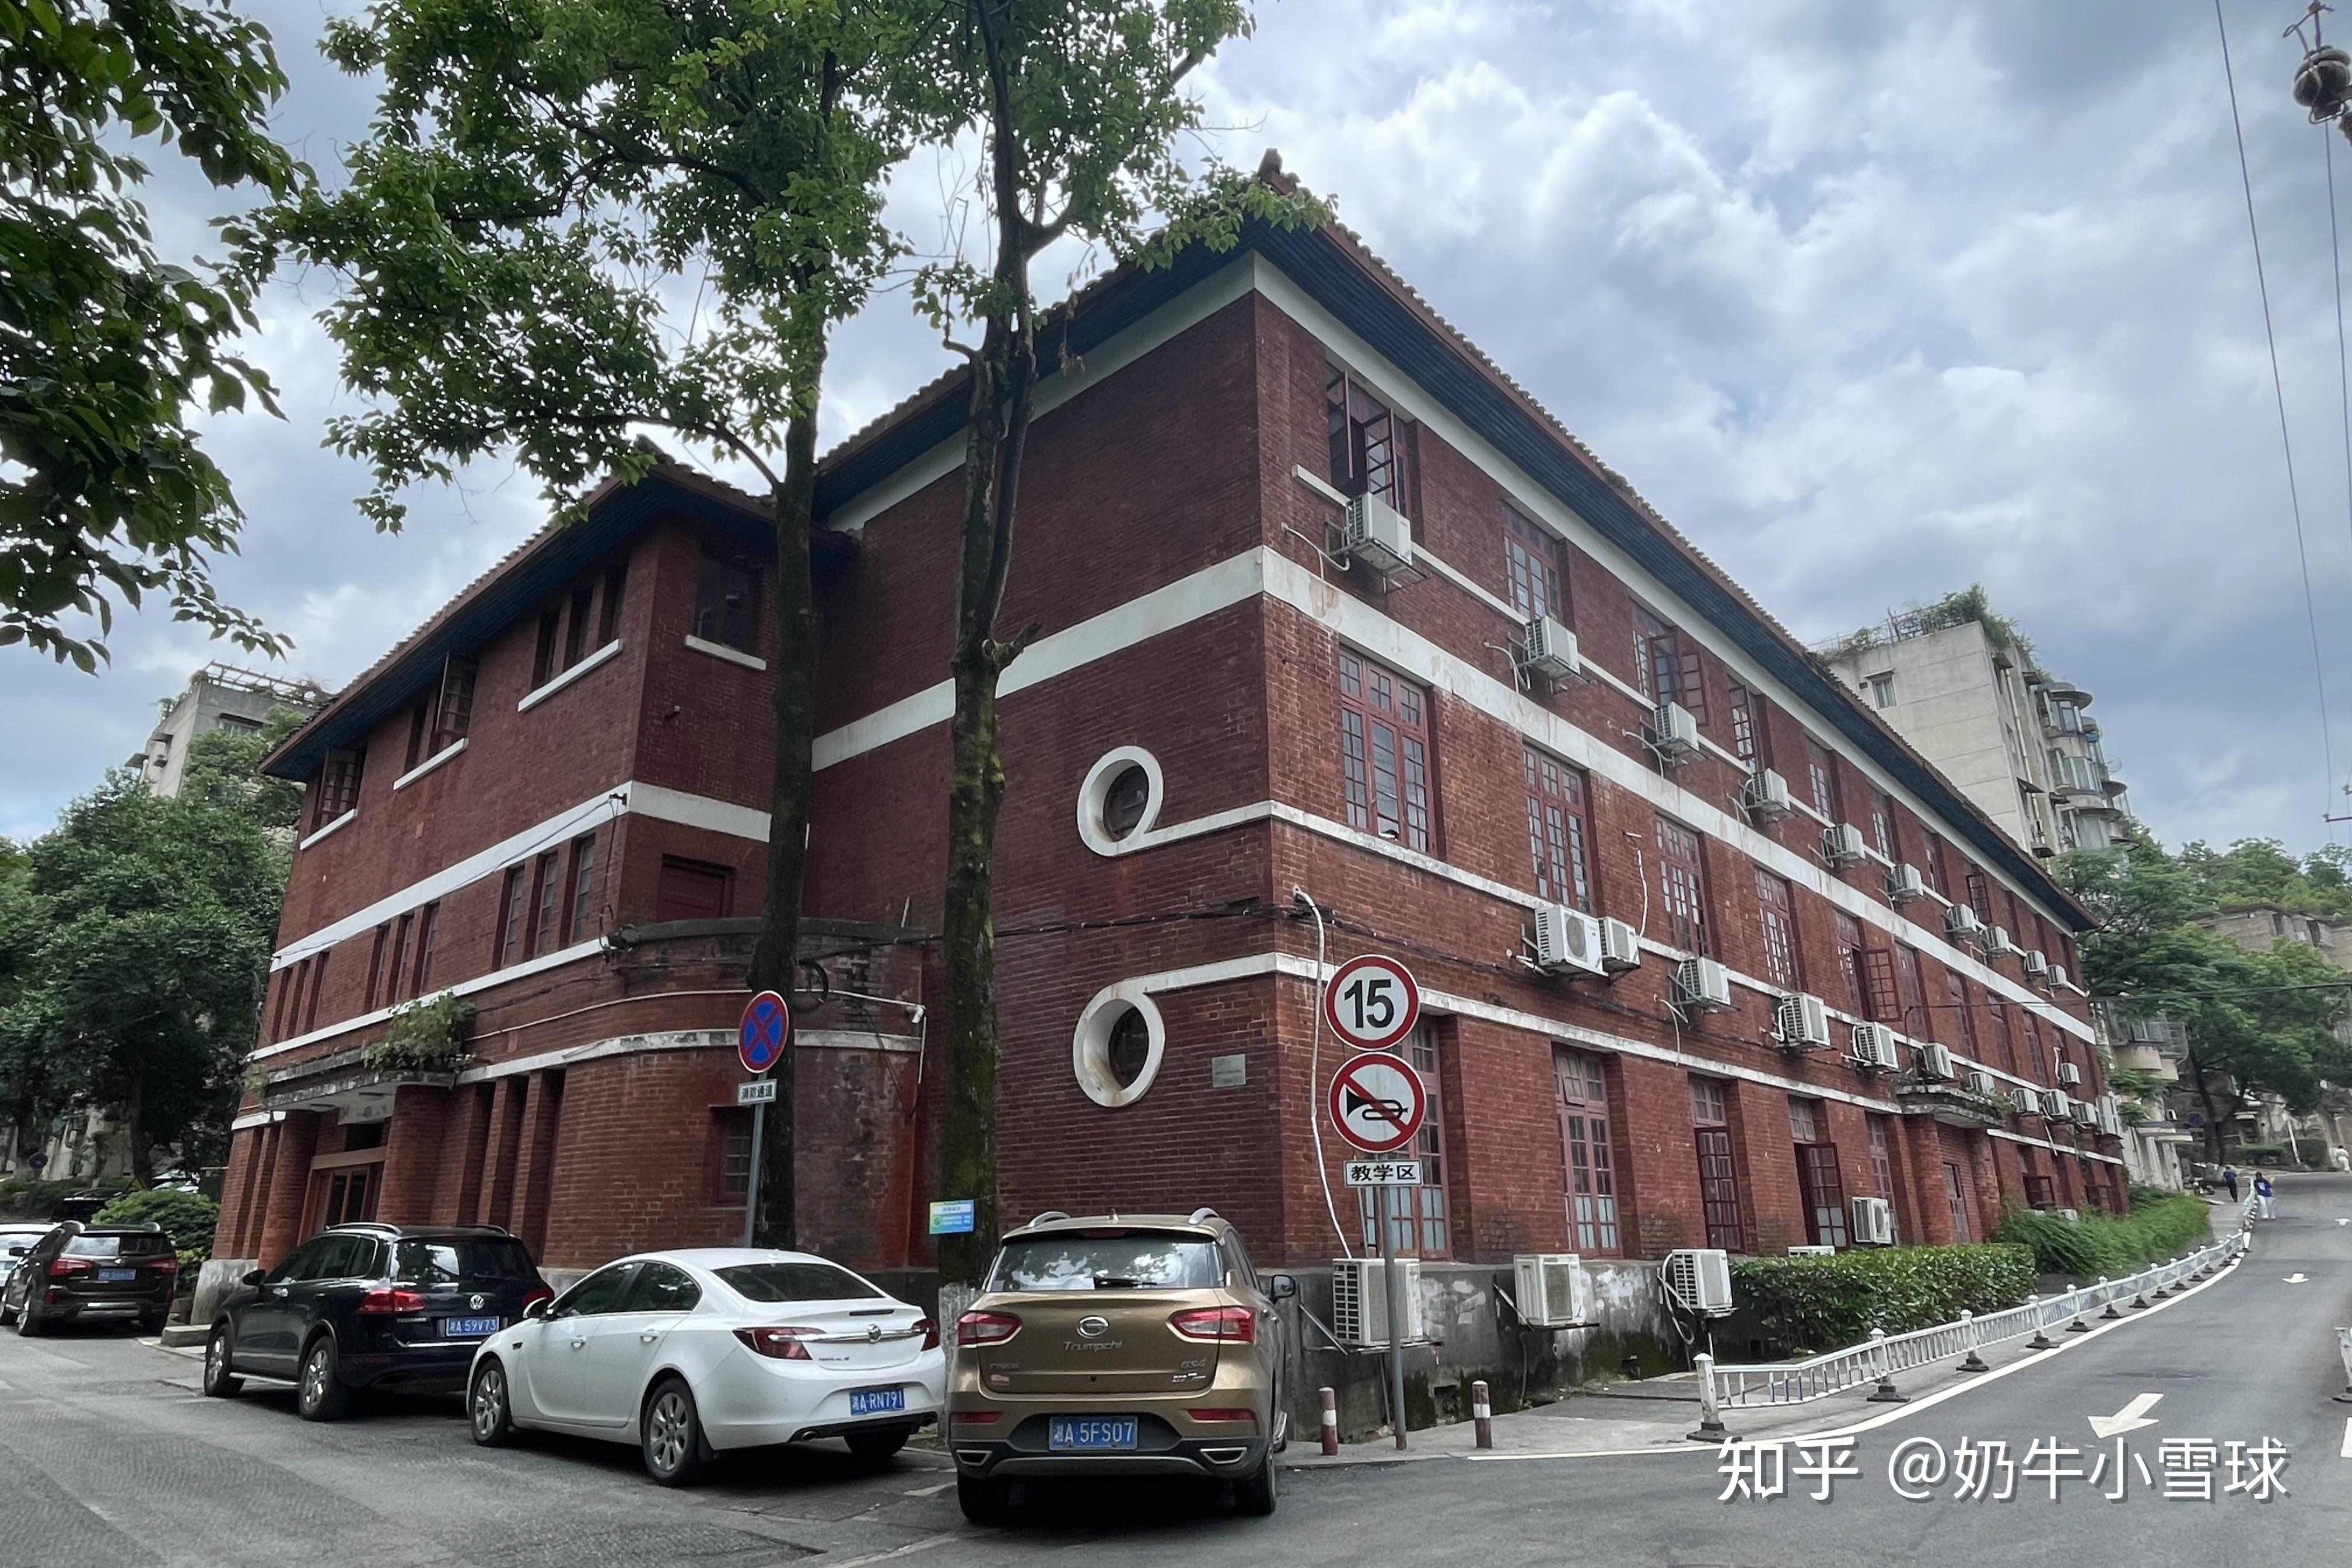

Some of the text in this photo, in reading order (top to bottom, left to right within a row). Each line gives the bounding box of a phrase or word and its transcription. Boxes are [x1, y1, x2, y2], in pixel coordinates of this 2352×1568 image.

[1344, 979, 1394, 1028] 15
[1351, 1165, 1416, 1181] 教学区
